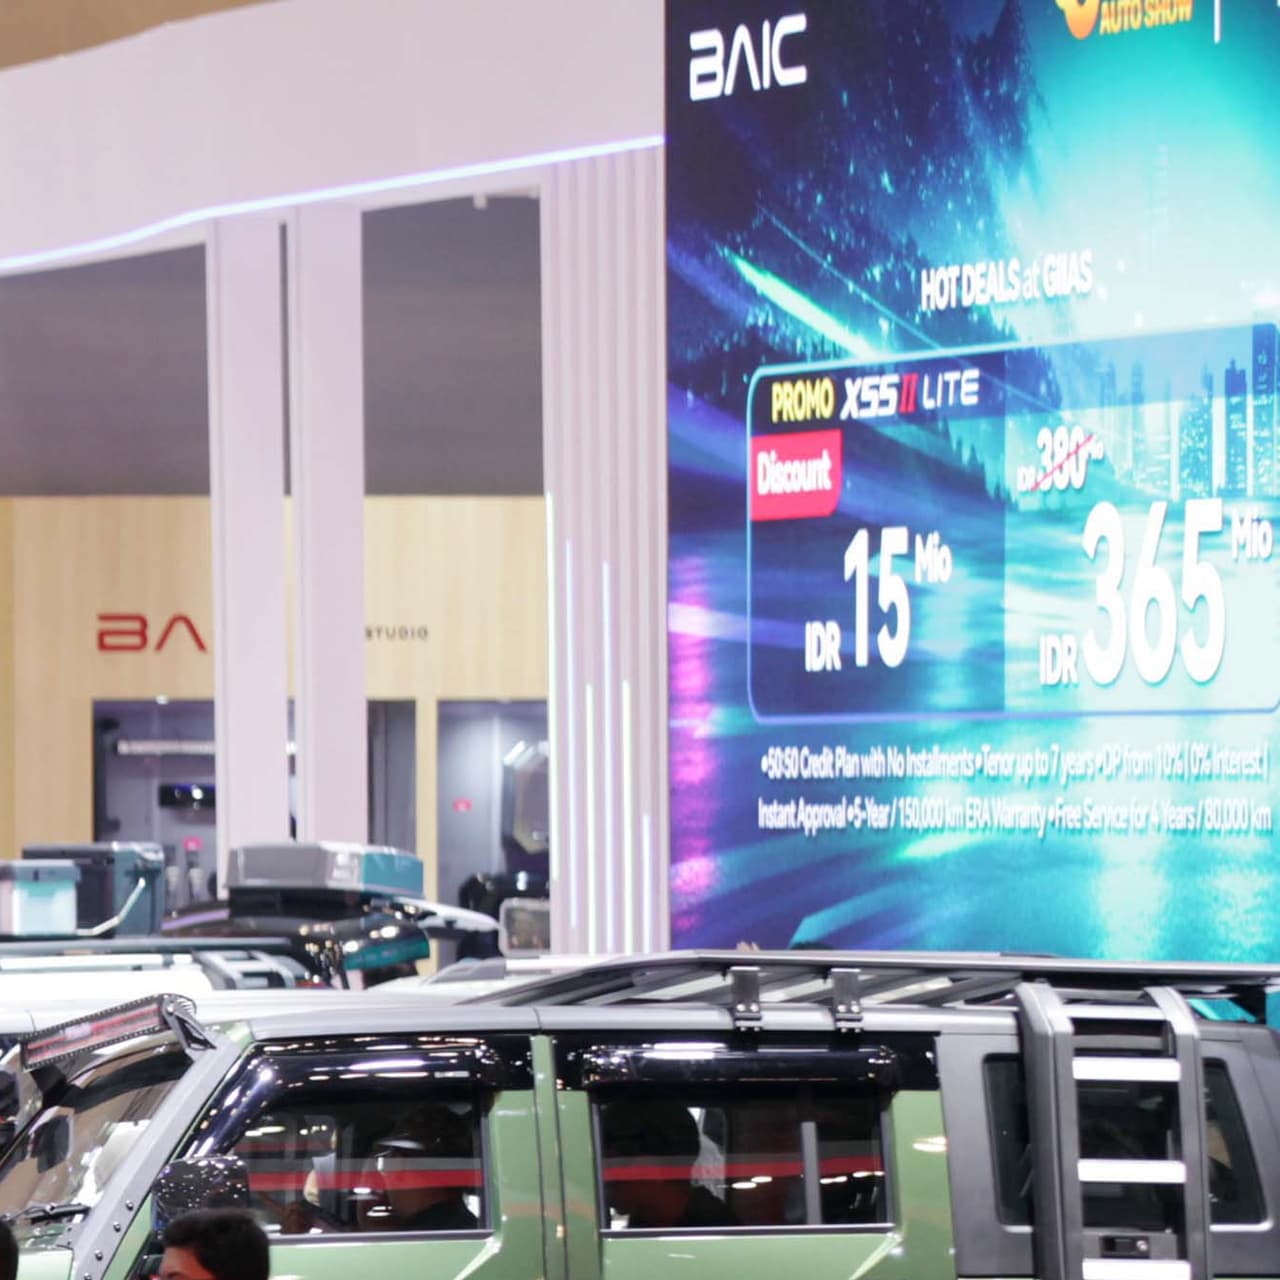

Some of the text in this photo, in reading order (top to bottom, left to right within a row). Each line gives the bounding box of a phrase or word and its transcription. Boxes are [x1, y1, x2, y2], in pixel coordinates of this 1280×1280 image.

[1099, 1, 1142, 36] AUTO
[689, 14, 807, 101] BAIC
[921, 249, 1093, 312] HOT DEALS at GIIAS
[772, 376, 834, 423] PROMO
[922, 369, 980, 411] LITE
[757, 450, 832, 495] Discount
[1037, 426, 1088, 492] 380
[805, 526, 952, 672] IDR 15 Mio
[1040, 500, 1273, 686] IDR 365 Mio
[97, 613, 207, 652] BA
[800, 745, 834, 779] Credit
[835, 745, 860, 778] Plan
[860, 745, 886, 778] with
[887, 745, 905, 778] No
[905, 744, 975, 777] Installments
[1016, 752, 1033, 784] up
[1034, 746, 1049, 776] to
[1050, 743, 1061, 776] 7
[1060, 752, 1094, 787] years
[1123, 742, 1153, 776] from
[758, 796, 797, 829] Instant
[797, 795, 846, 837] Approval
[944, 797, 964, 828] km
[1084, 796, 1129, 830] Service
[1130, 796, 1148, 830] for
[1250, 798, 1273, 830] km
